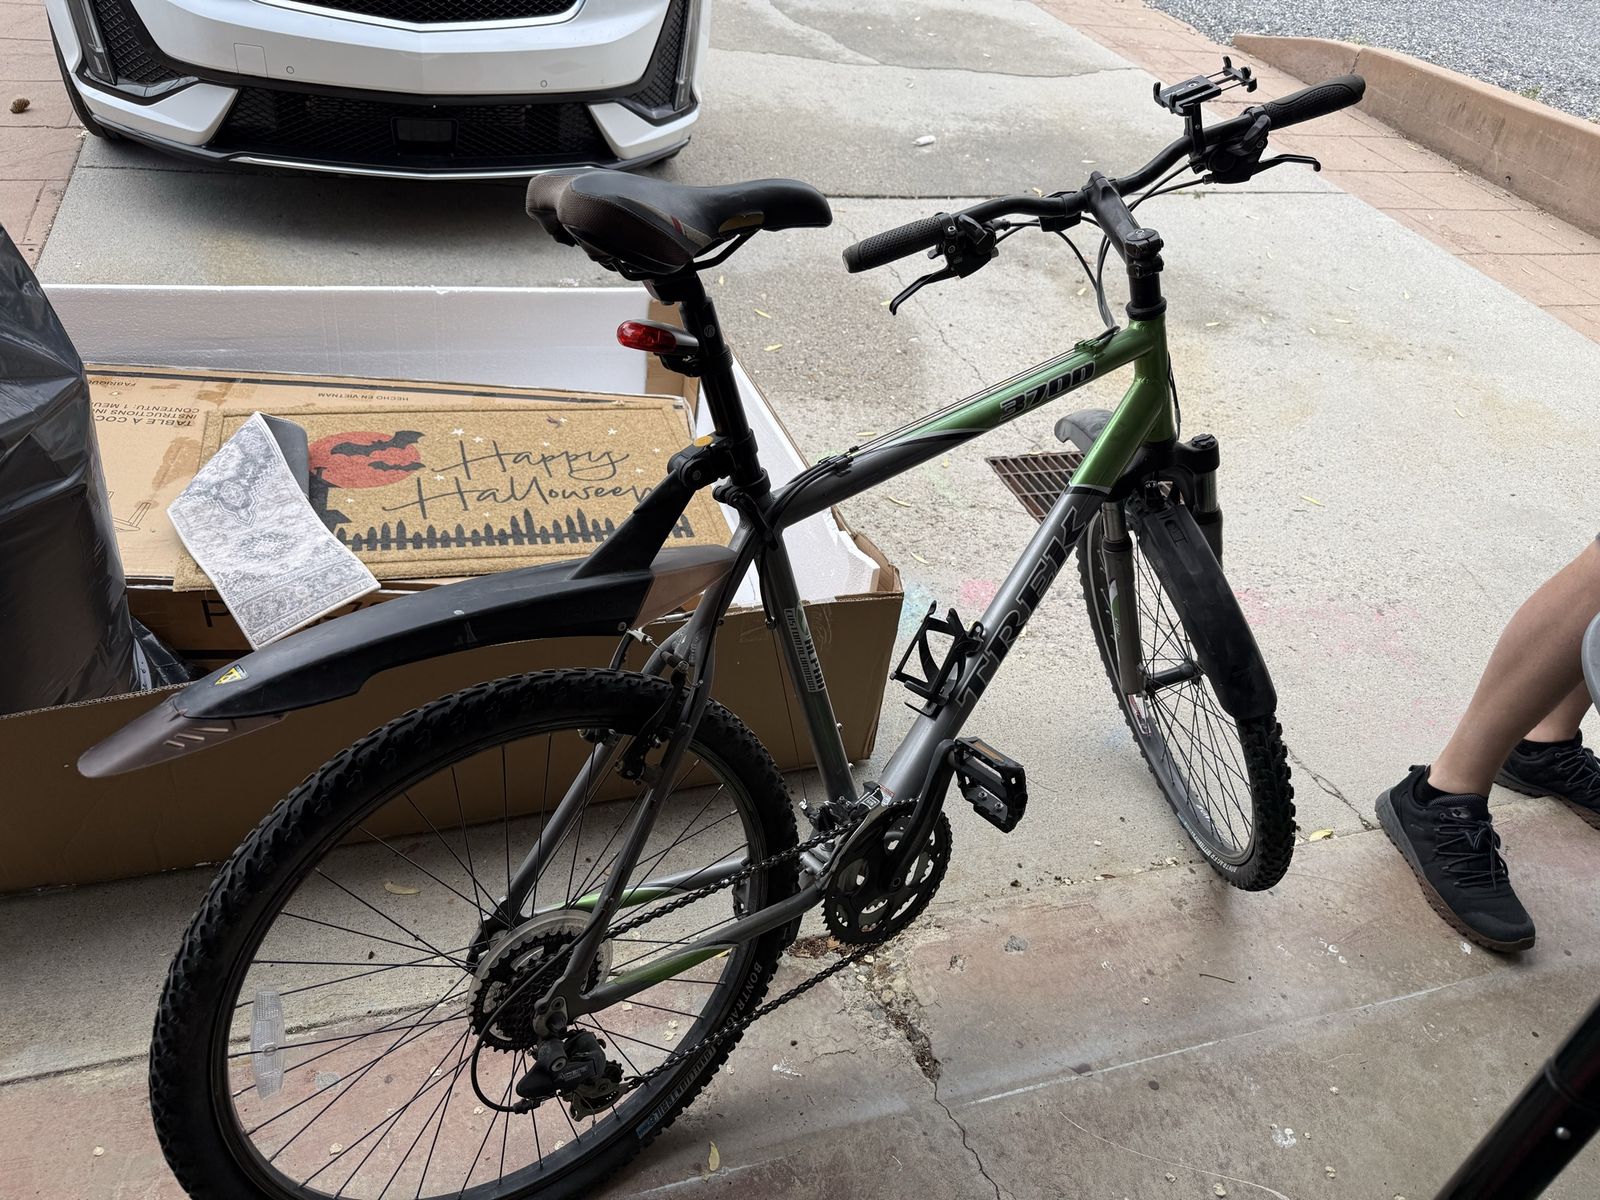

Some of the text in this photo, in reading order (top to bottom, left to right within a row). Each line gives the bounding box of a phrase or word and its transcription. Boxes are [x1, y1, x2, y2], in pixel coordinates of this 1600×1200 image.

[1000, 361, 1096, 420] 3700
[110, 410, 198, 420] INSTRUCTIONS
[146, 418, 193, 427] TABLE
[432, 440, 629, 481] Happy
[956, 505, 1087, 707] TREK
